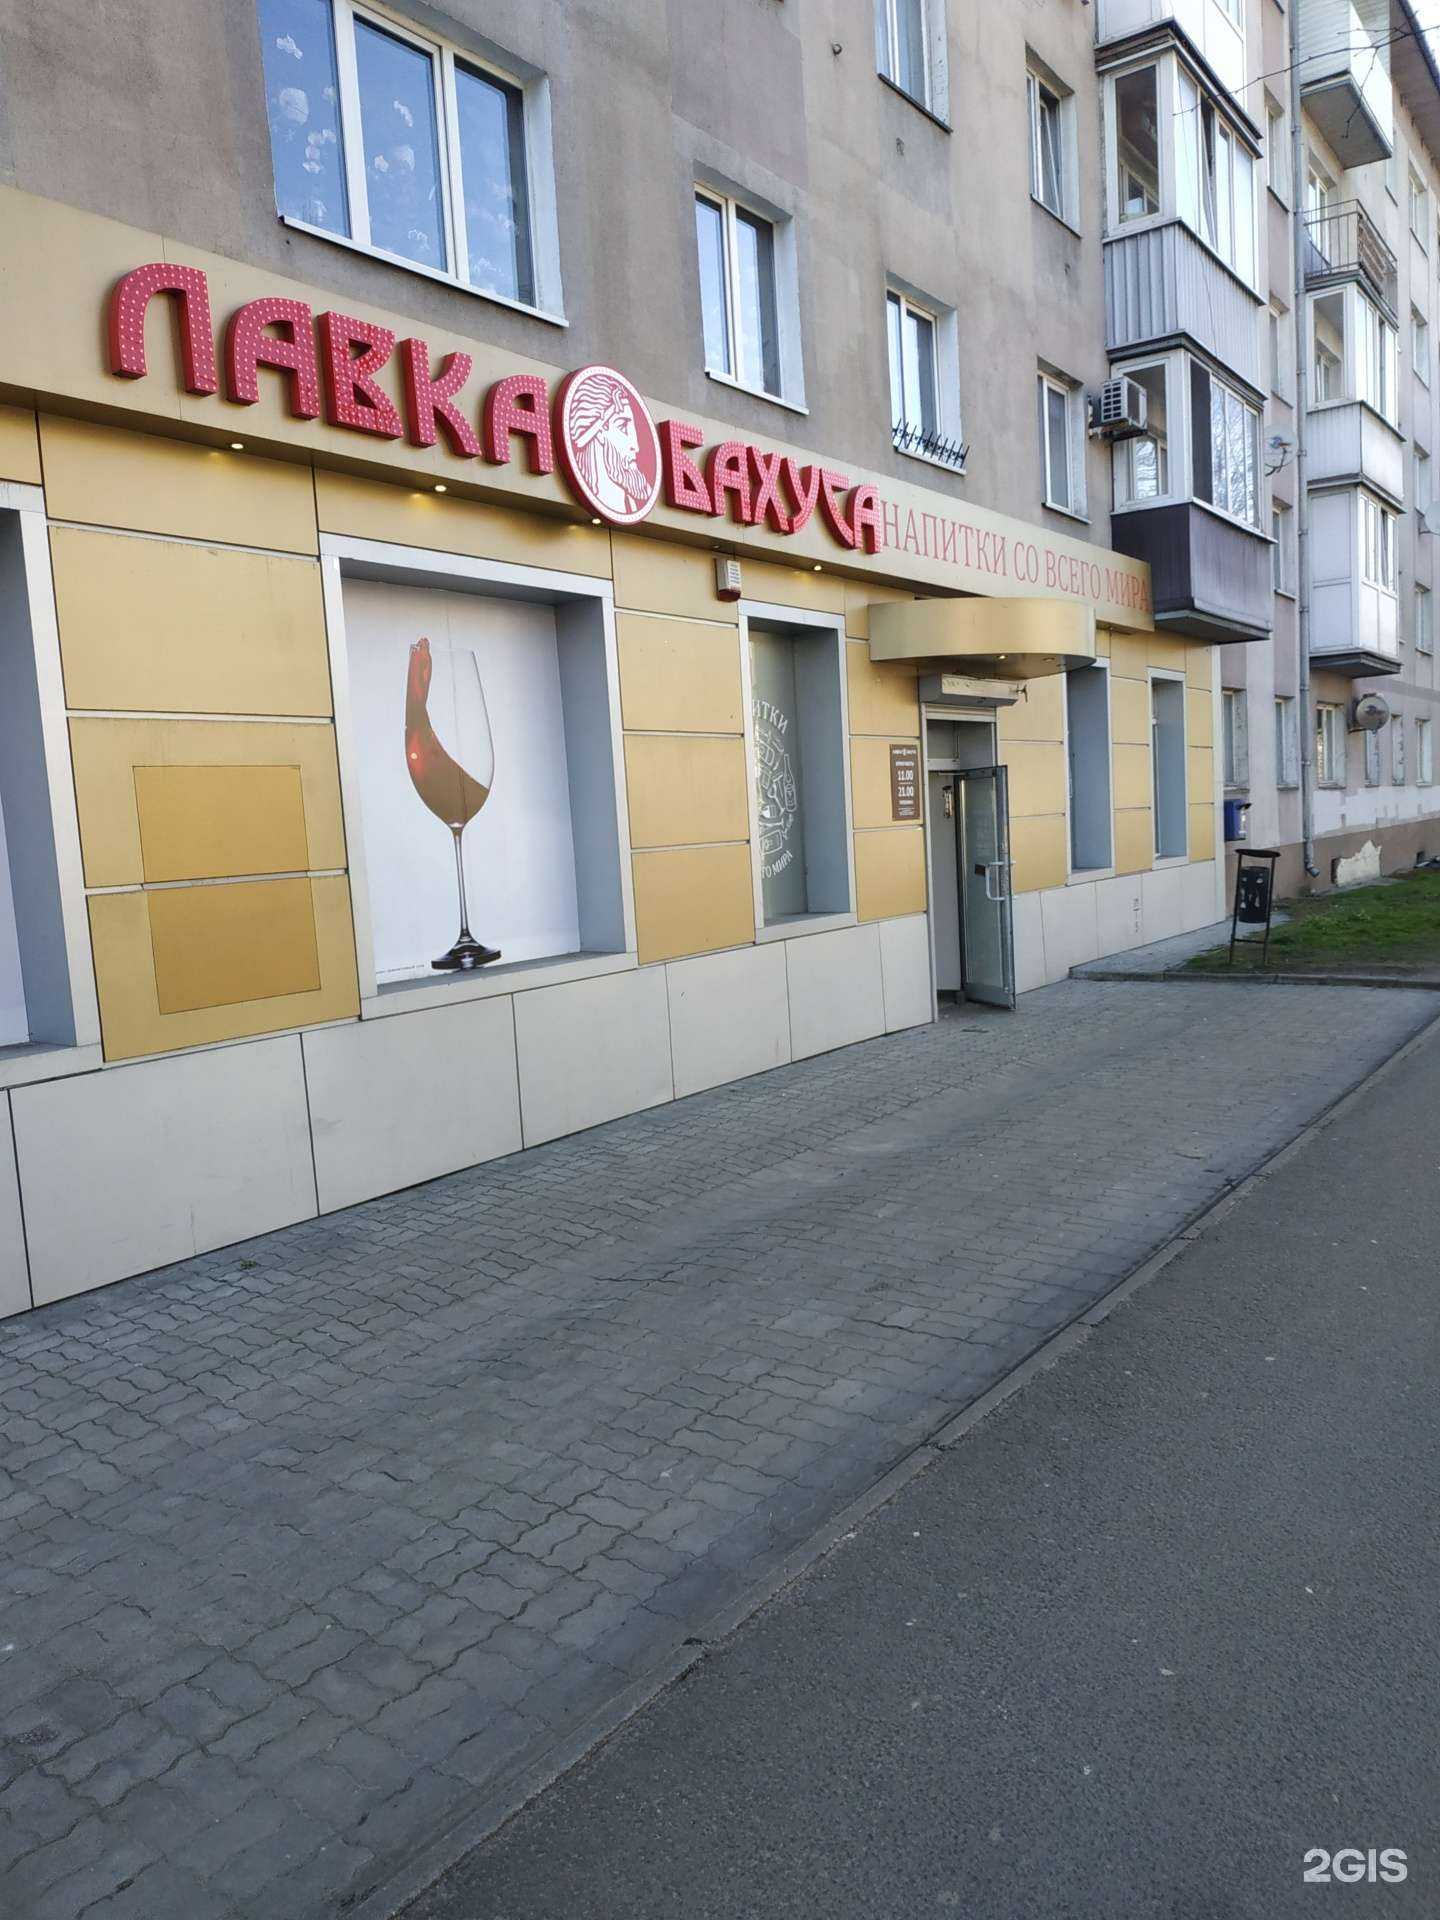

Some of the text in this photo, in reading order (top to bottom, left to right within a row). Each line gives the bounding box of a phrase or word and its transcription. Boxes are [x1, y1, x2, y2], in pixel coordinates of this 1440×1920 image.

[108, 262, 882, 554] ЛАВКА БАХУСА
[880, 500, 1150, 612] НАПИТКИ СО ВСЕГО МИРА
